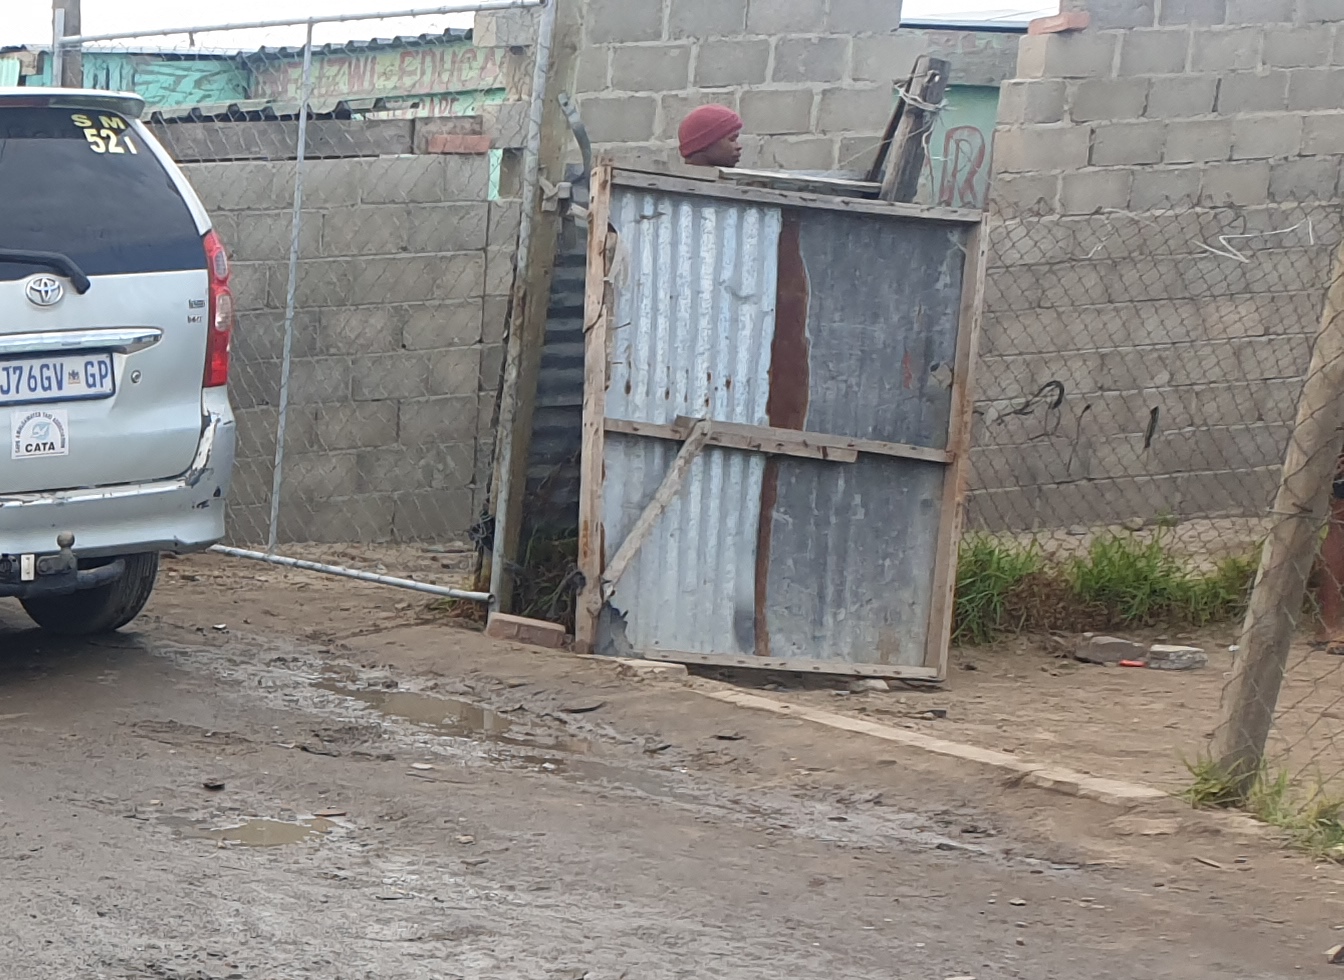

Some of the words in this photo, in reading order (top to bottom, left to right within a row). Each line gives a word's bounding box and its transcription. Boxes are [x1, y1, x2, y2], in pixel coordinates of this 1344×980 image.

[71, 114, 92, 127] S
[98, 115, 126, 130] M
[83, 128, 137, 154] 521
[84, 360, 109, 389] GP
[25, 441, 56, 453] CATA
